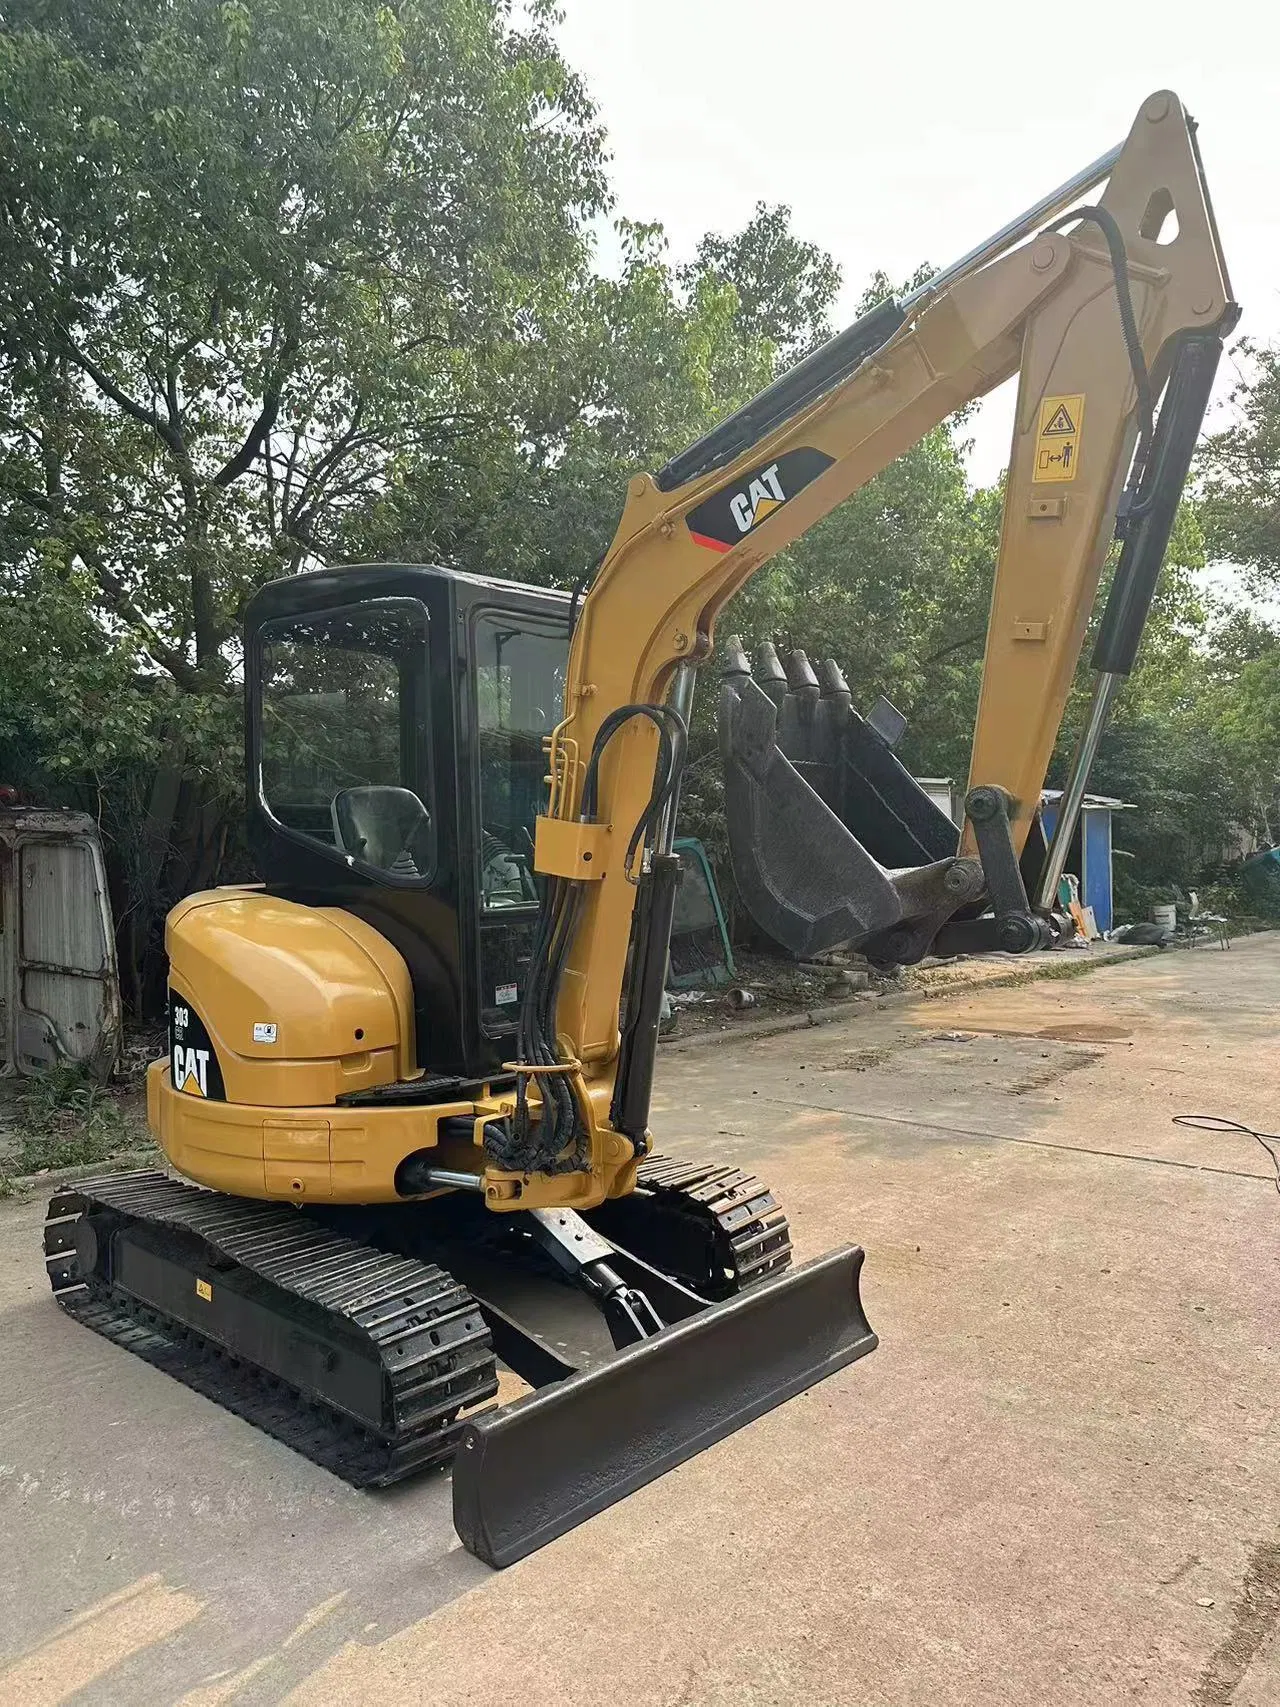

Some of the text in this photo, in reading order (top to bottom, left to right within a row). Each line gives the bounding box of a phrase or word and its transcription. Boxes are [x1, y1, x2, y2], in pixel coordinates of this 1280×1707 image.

[729, 463, 786, 533] CAT
[174, 1006, 189, 1028] 303
[173, 1044, 210, 1098] CAT
